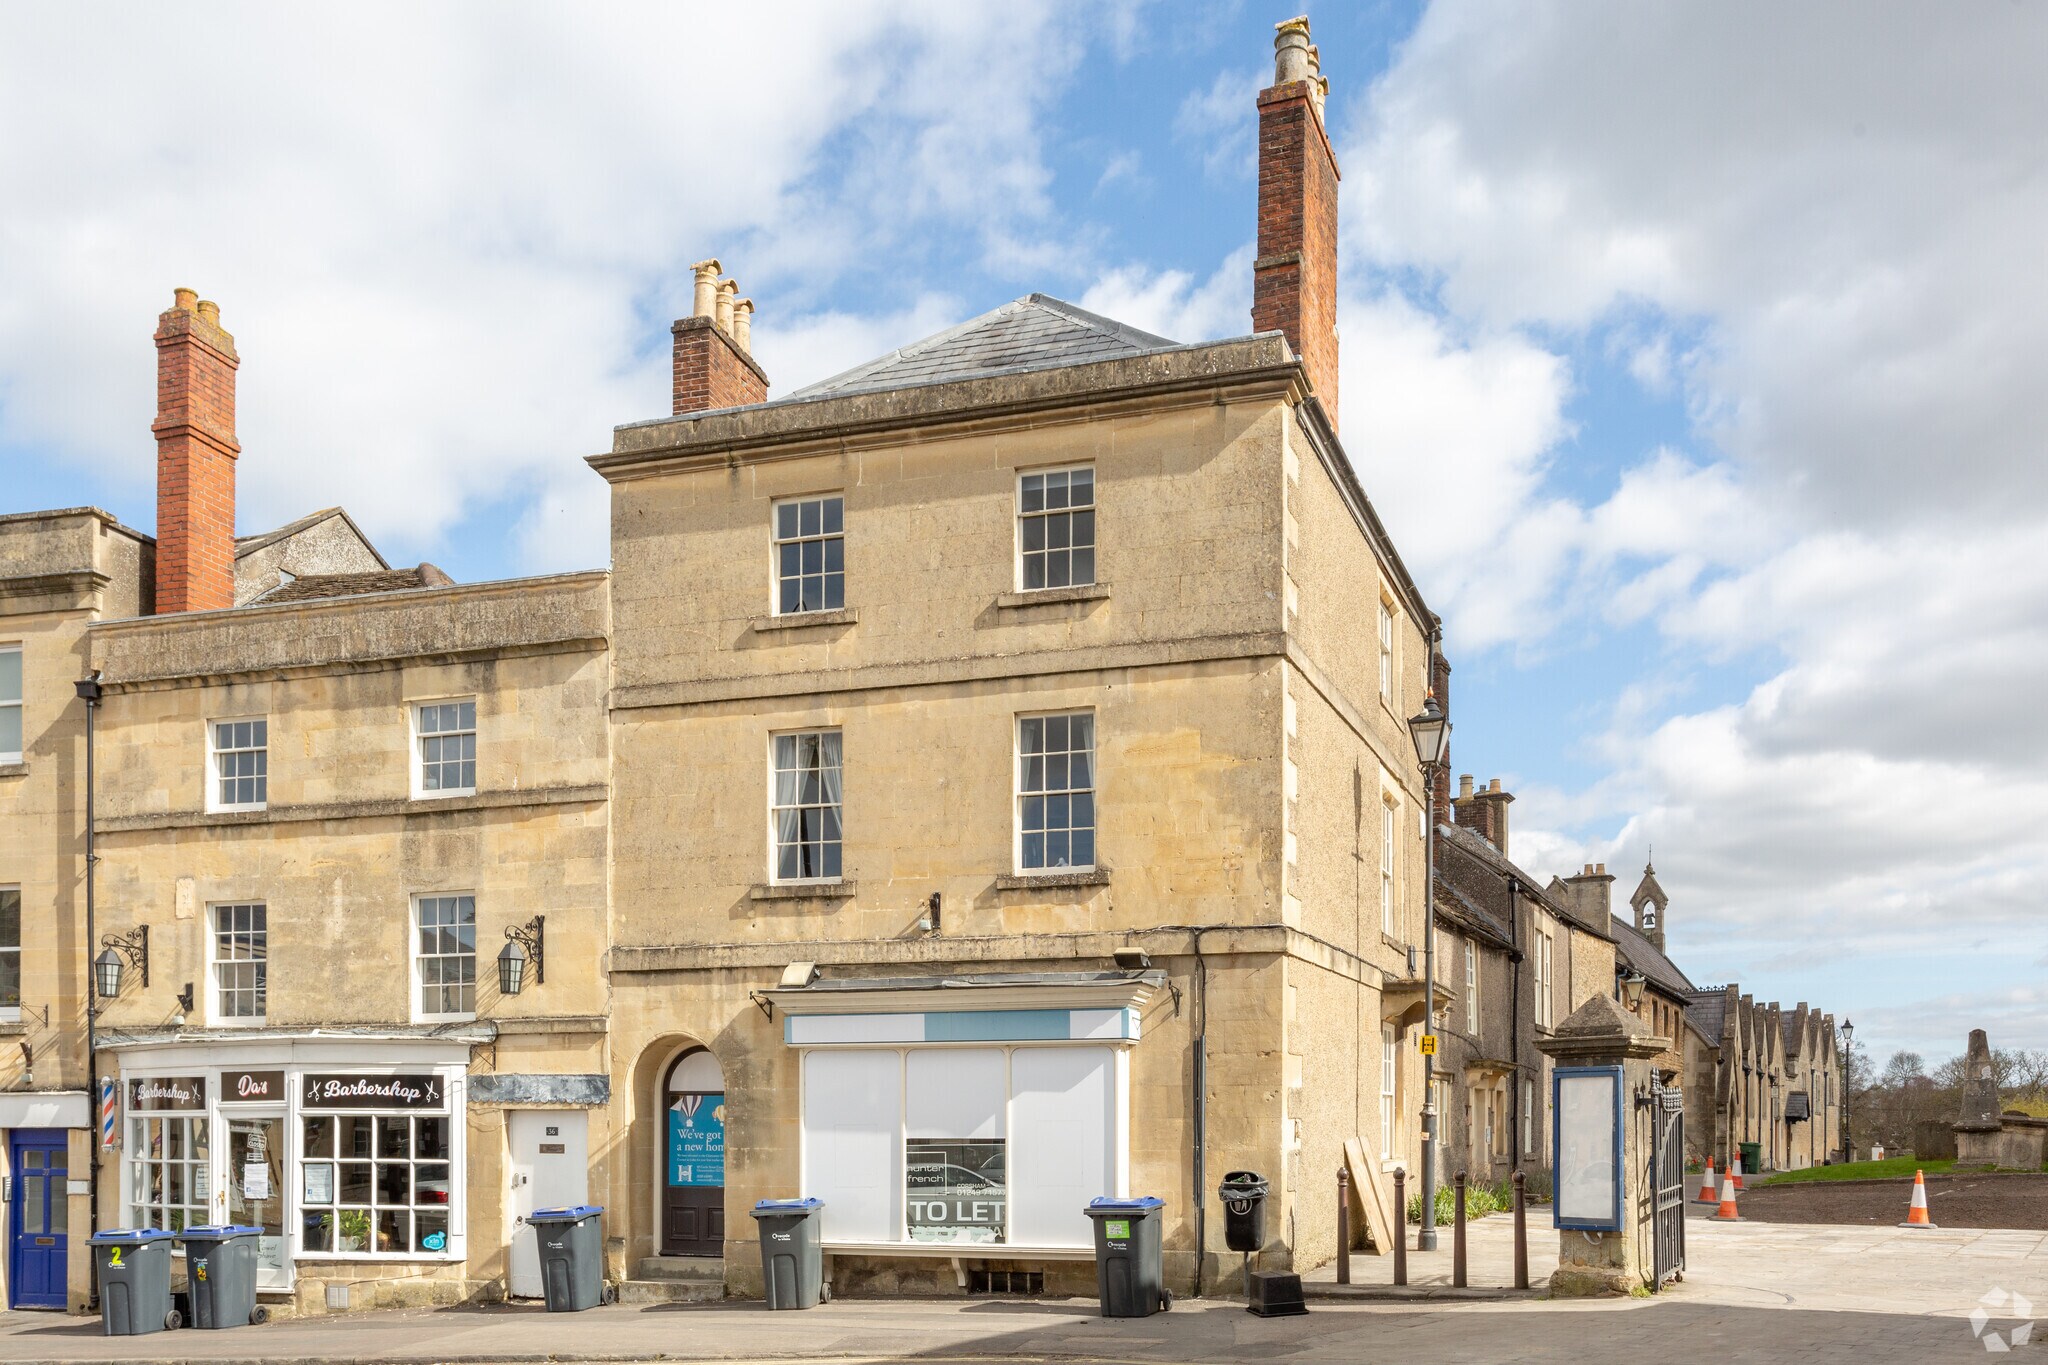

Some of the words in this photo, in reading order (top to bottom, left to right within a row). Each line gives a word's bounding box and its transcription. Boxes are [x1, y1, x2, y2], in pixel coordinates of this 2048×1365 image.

[137, 1082, 190, 1104] Barbershop
[324, 1078, 421, 1103] Barbershop
[677, 1129, 704, 1139] We've
[706, 1132, 722, 1142] got
[907, 1174, 944, 1182] french
[909, 1201, 948, 1221] TO
[956, 1201, 1006, 1221] LET
[111, 1247, 122, 1265] 2
